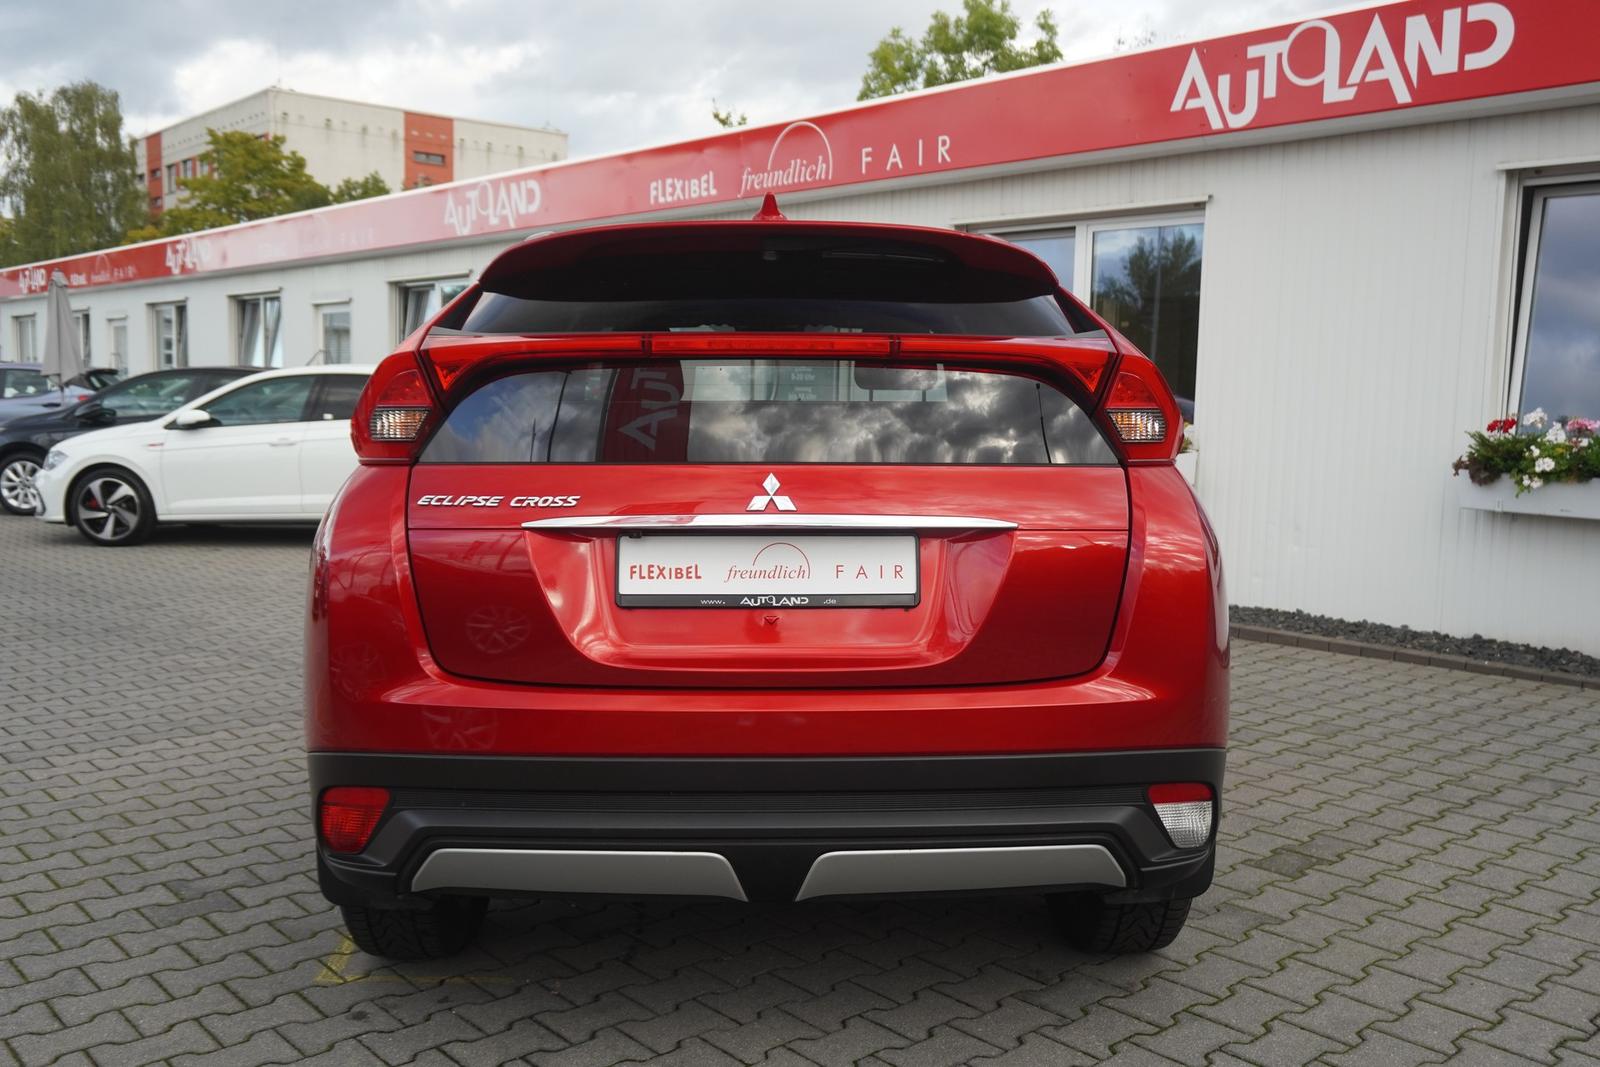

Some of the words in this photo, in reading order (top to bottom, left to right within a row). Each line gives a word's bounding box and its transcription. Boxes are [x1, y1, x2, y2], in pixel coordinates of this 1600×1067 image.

[1170, 2, 1515, 130] AUTOLAND
[650, 170, 717, 205] FLEXIBEL
[737, 155, 827, 198] freundlich
[443, 179, 541, 235] AUTOLAND
[417, 495, 505, 506] ECLIPSE
[510, 495, 580, 507] CROSS
[629, 564, 702, 580] FLEXIBEL
[724, 564, 806, 583] freundlich
[835, 564, 903, 579] FAIR
[740, 595, 809, 607] AUTOLAND
